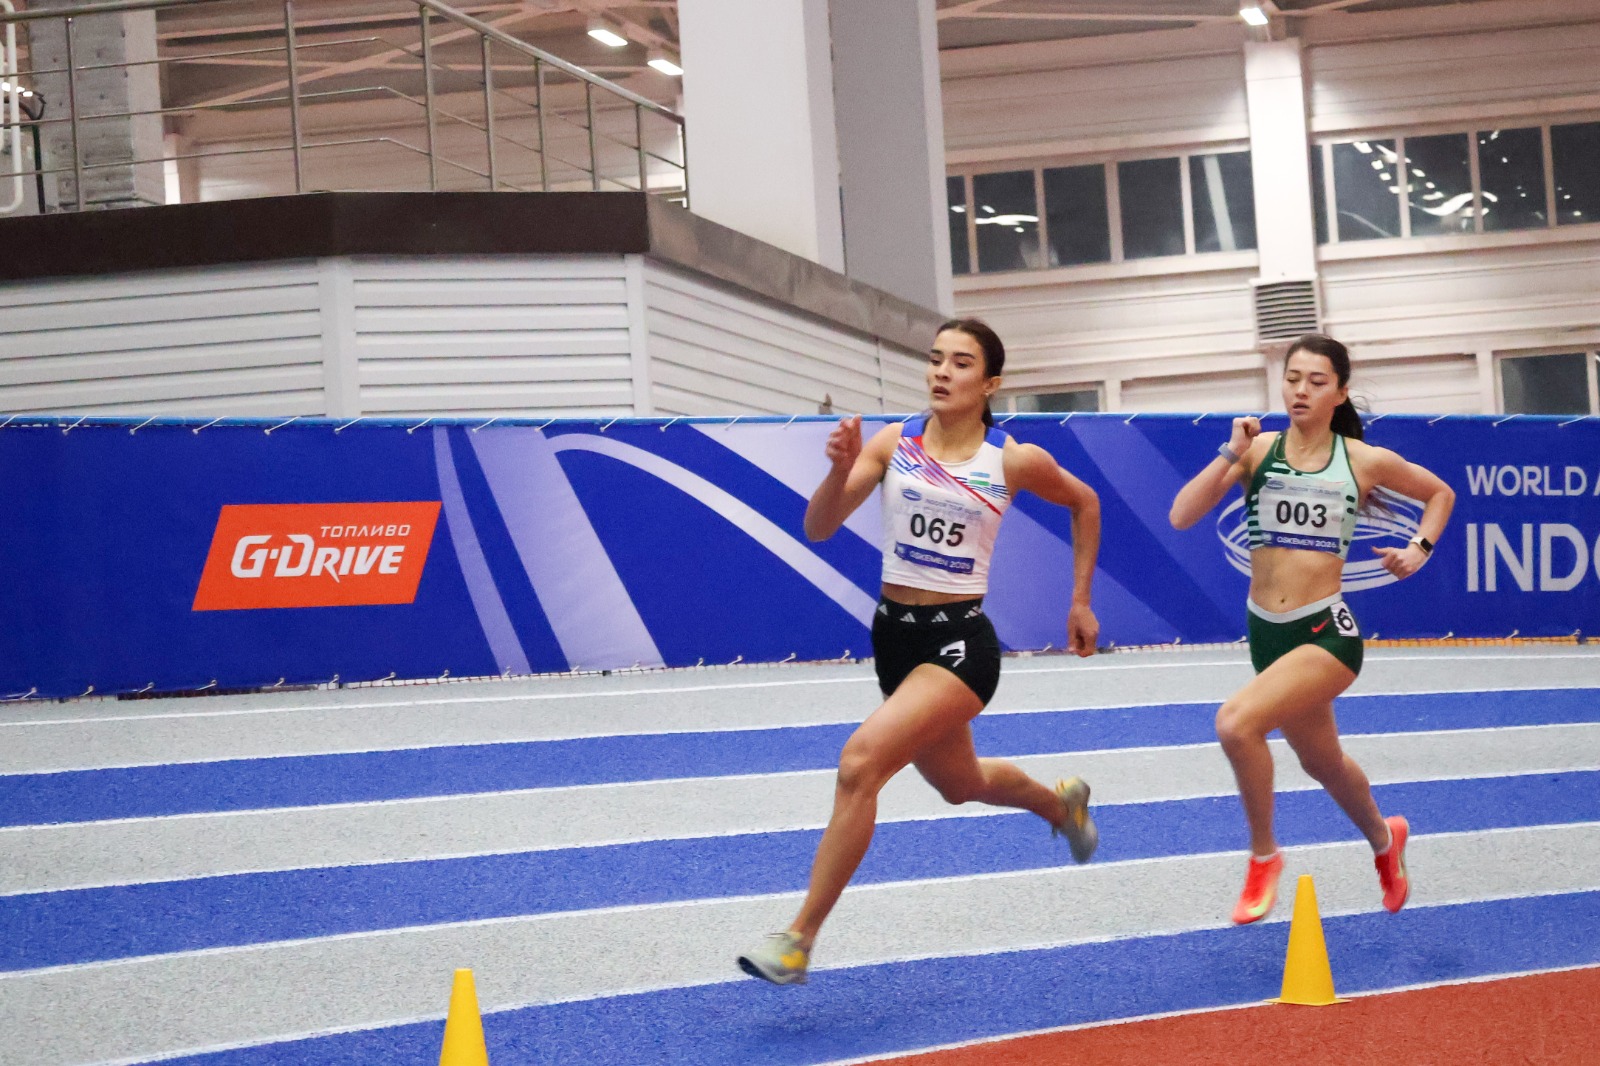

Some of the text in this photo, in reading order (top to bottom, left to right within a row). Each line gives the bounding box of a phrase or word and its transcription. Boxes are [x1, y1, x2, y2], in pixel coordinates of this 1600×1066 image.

[1466, 465, 1588, 496] WORLD
[1275, 500, 1327, 528] 003
[320, 524, 411, 538] ТОПЛИВО
[910, 513, 966, 547] 065
[1277, 536, 1337, 548] OSKEMEN 2026
[1466, 523, 1600, 592] IND
[1336, 608, 1353, 631] 6
